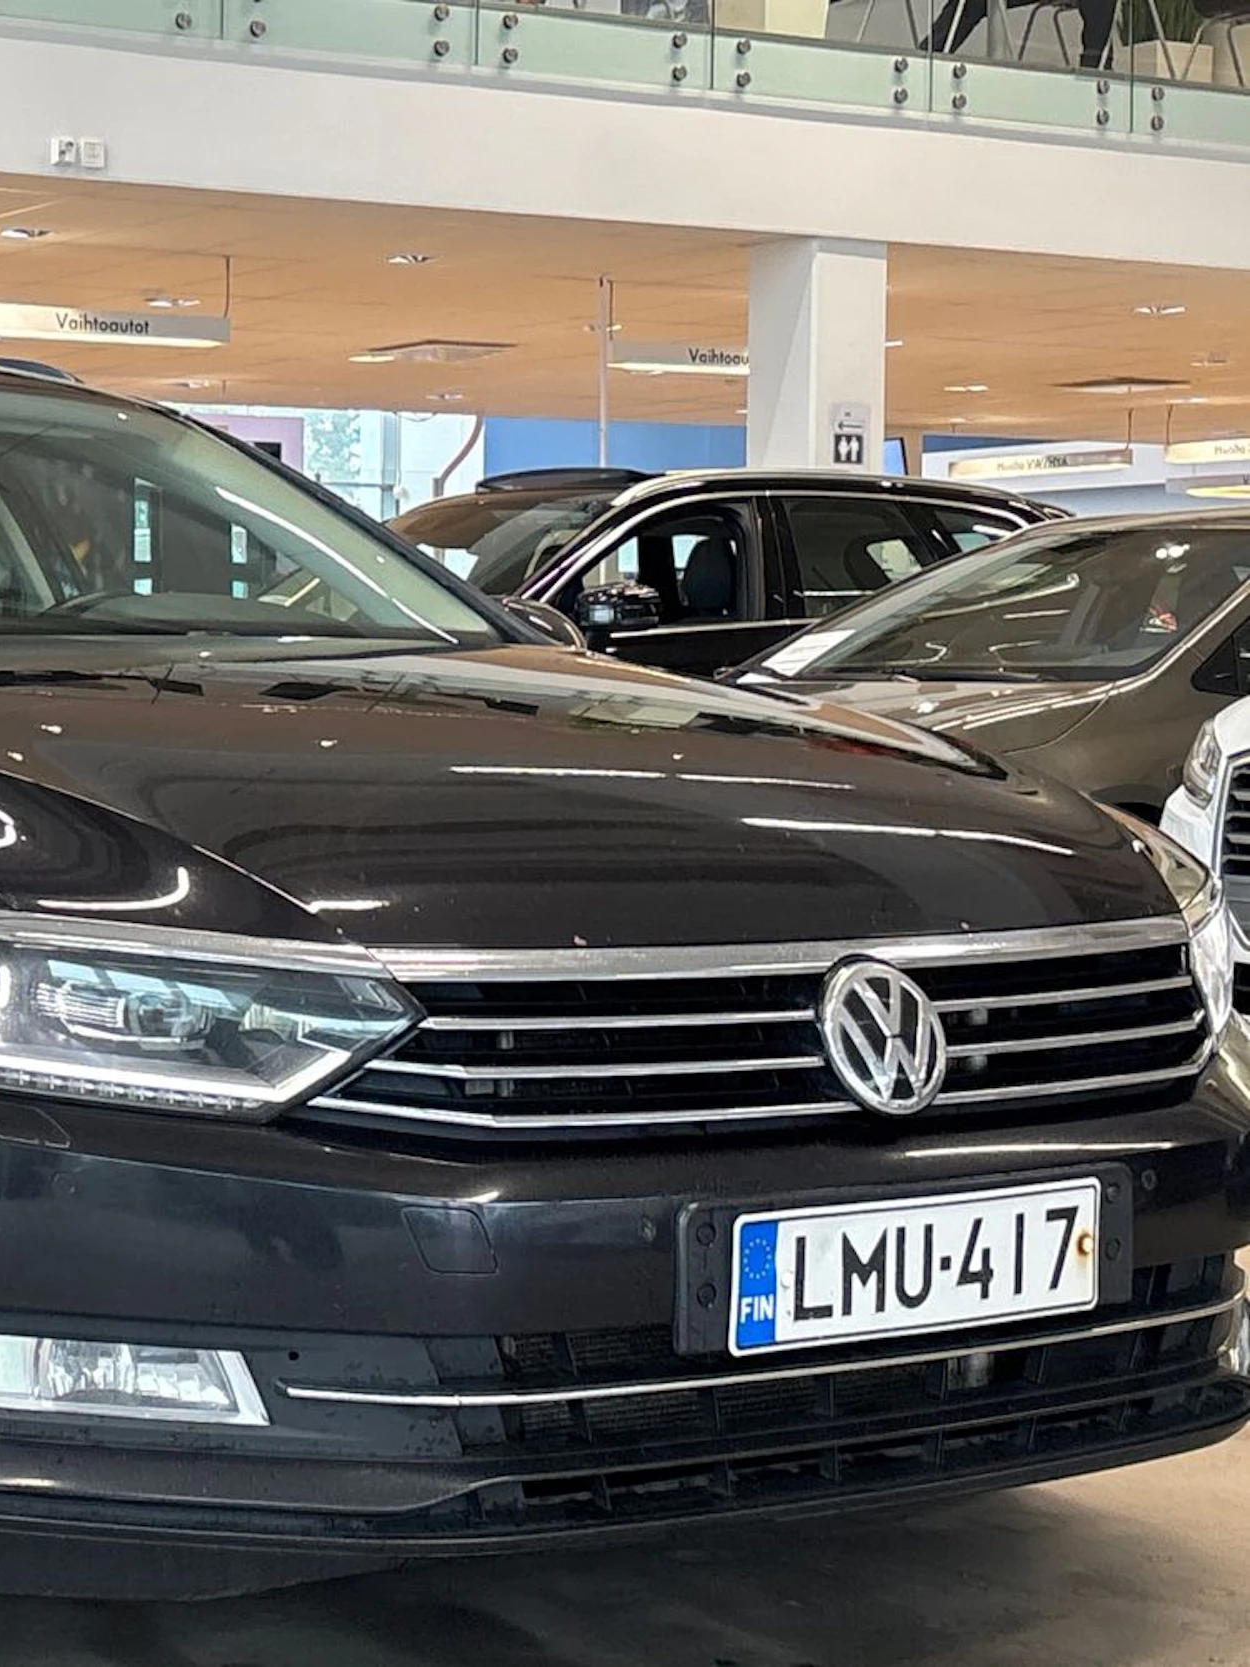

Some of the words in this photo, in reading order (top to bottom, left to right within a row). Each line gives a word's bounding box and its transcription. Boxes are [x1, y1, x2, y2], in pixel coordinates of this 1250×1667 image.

[55, 312, 150, 335] Vaihtoautot
[793, 1205, 1080, 1321] LMU-417
[739, 1293, 775, 1324] FIN
